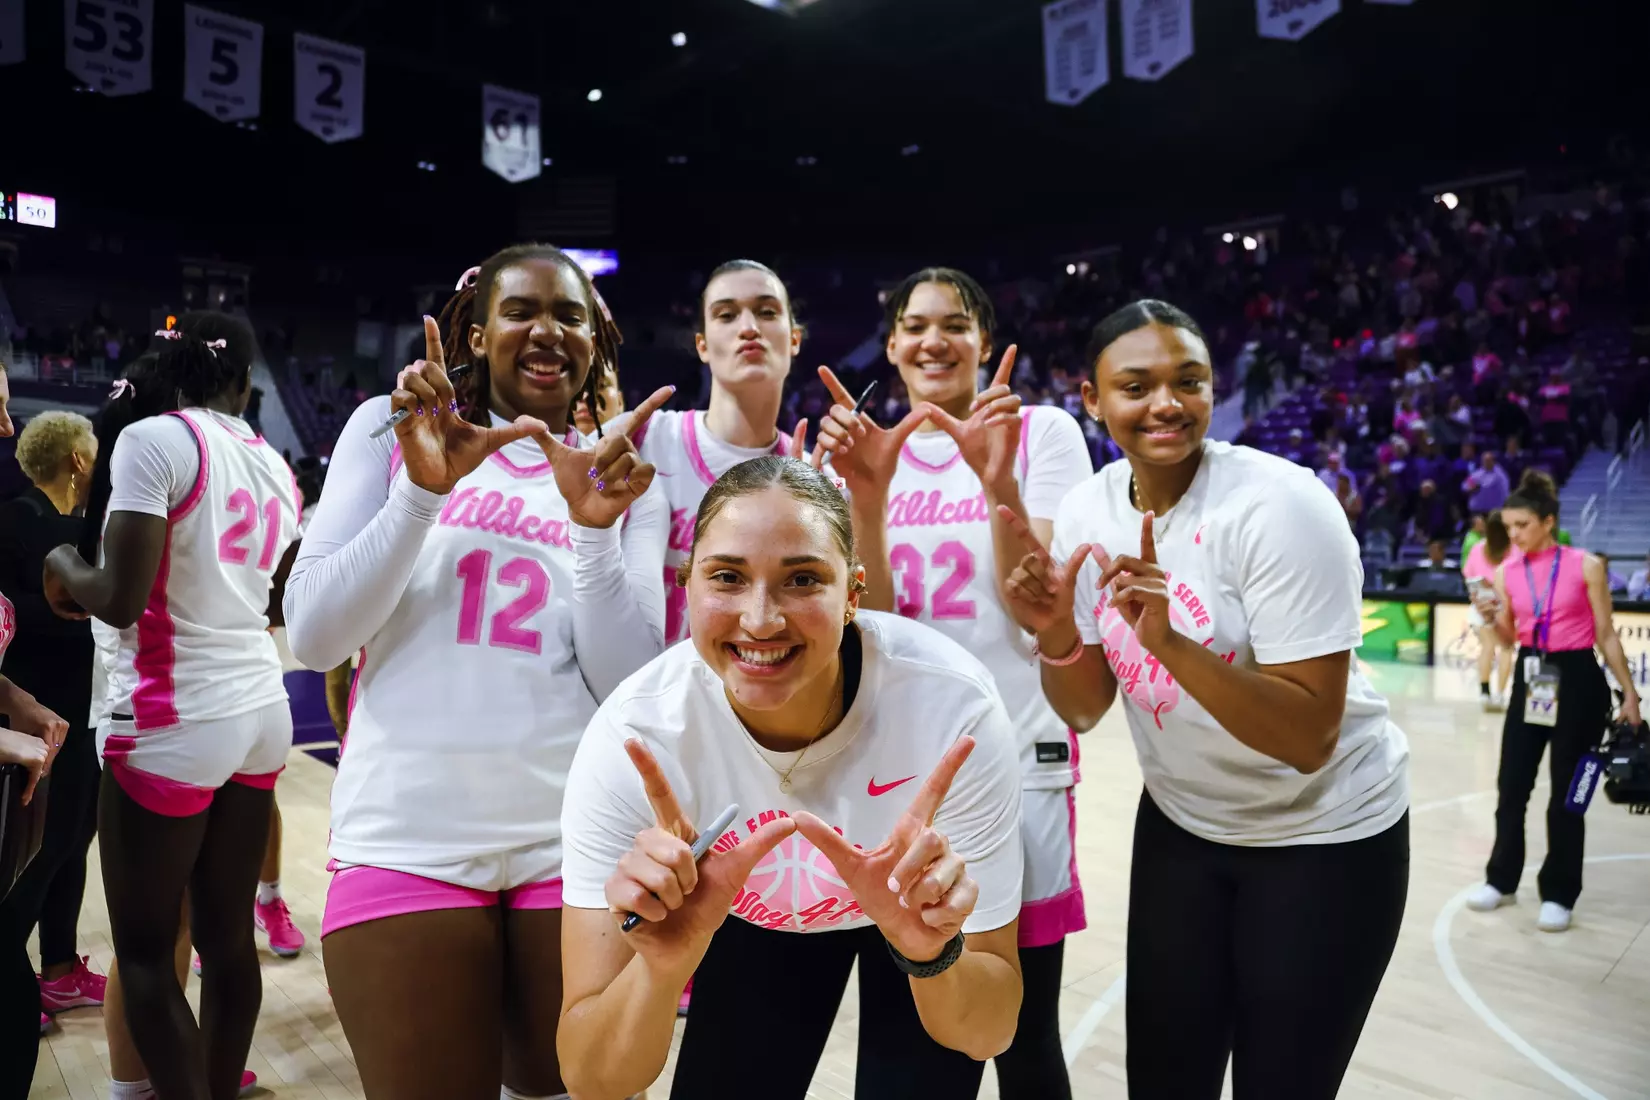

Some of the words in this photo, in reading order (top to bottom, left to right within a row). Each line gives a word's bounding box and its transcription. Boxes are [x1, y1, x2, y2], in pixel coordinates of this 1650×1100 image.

[72, 1, 144, 63] 53
[209, 37, 239, 86] 5
[315, 63, 343, 110] 2
[26, 205, 47, 219] 50
[218, 487, 281, 571] 21
[456, 548, 551, 656] 12
[889, 541, 977, 620] 32
[1172, 582, 1211, 629] SERVE
